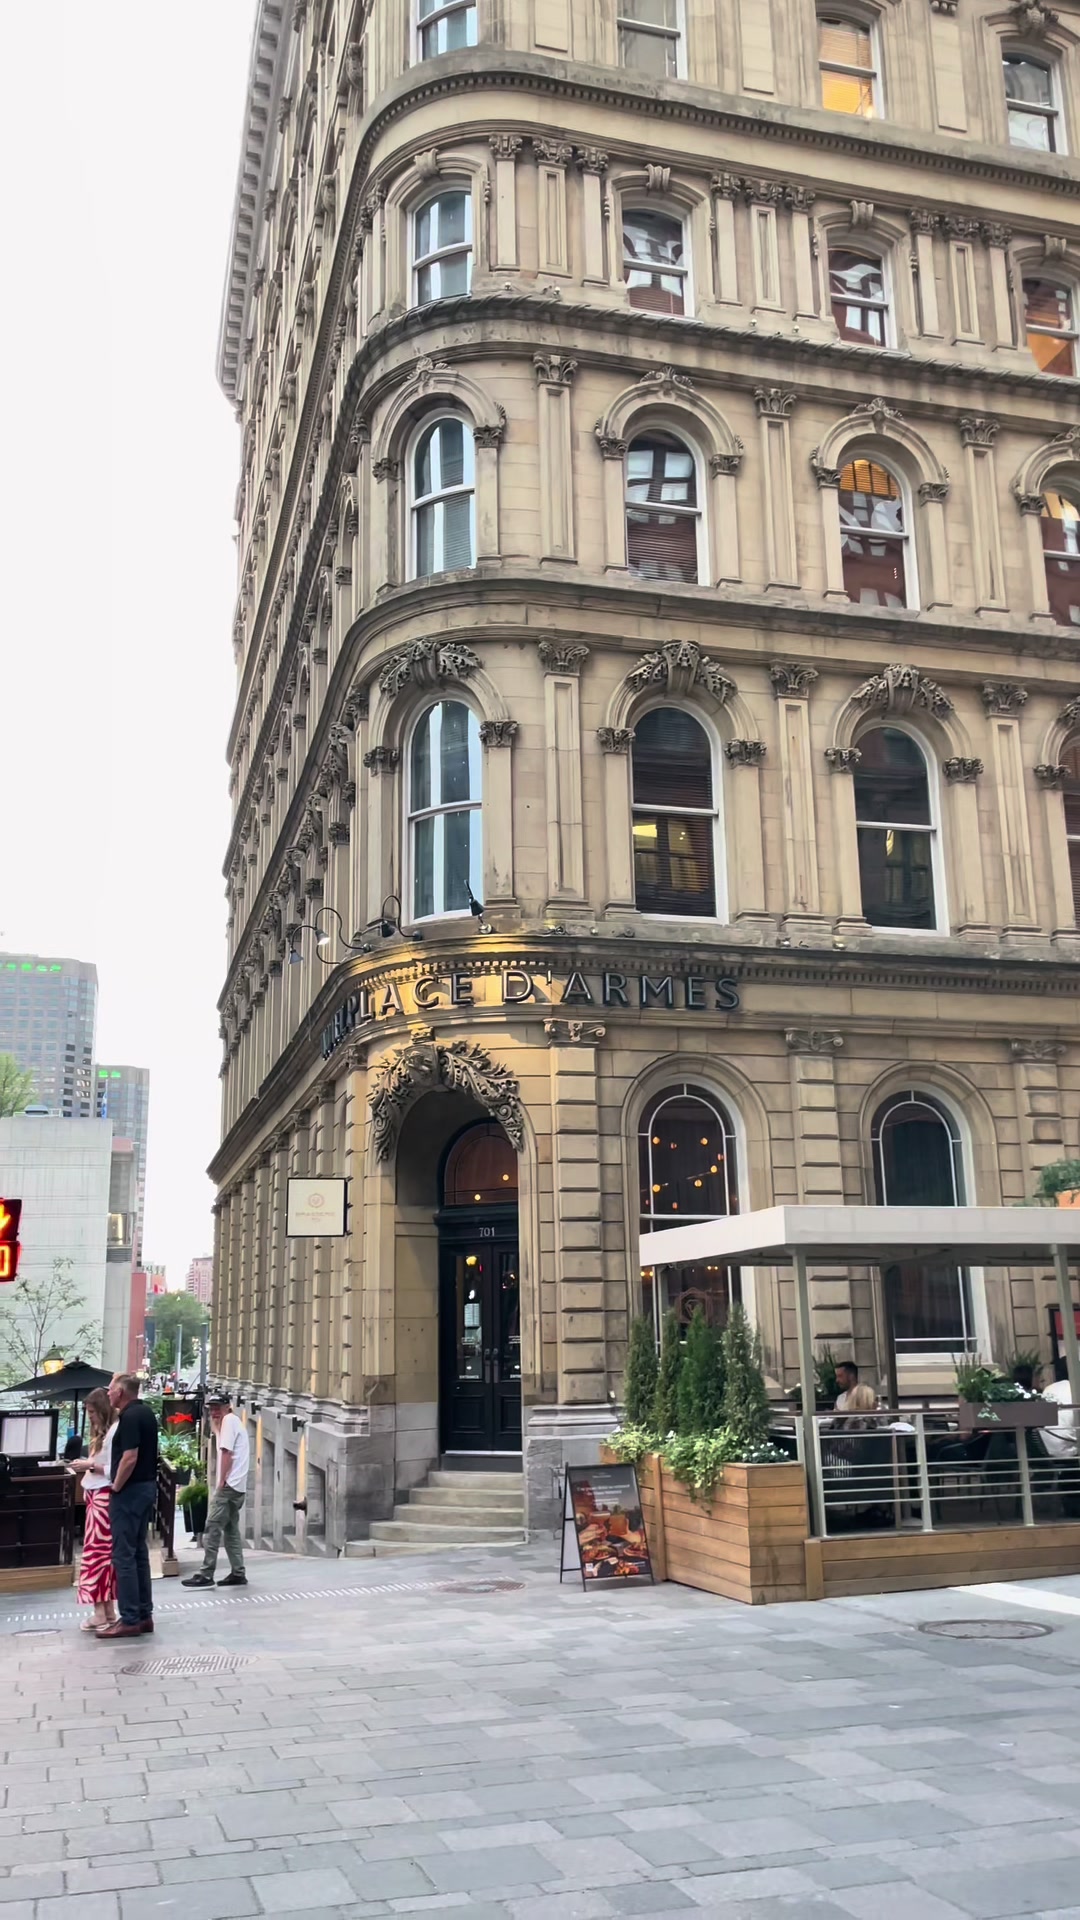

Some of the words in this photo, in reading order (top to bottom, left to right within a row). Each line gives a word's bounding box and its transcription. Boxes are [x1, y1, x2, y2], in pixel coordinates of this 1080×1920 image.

[346, 971, 473, 1027] PLACE
[501, 968, 741, 1010] D'ARMES
[478, 1226, 495, 1238] 701
